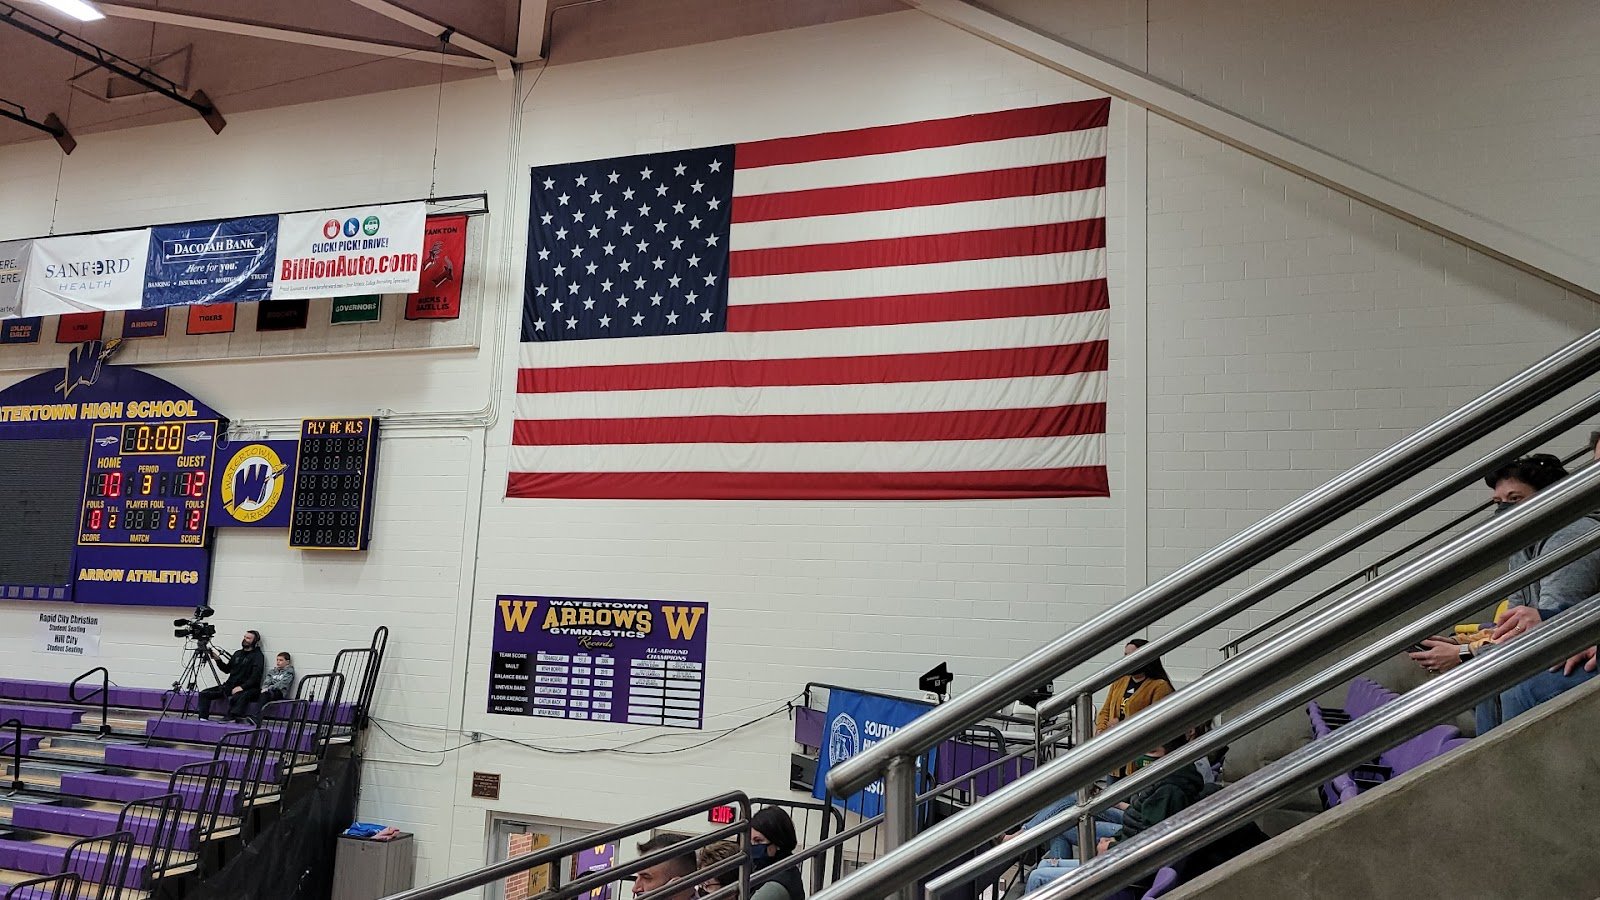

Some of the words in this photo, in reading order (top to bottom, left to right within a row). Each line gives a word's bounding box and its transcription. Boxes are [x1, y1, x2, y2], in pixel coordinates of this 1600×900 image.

[174, 240, 224, 254] DACOTAH
[225, 238, 255, 250] BANK
[312, 240, 337, 254] CLICK!
[338, 239, 361, 252] PICK!
[362, 237, 389, 249] DRIVE!
[45, 257, 131, 279] SANFORD
[186, 264, 205, 273] Here
[205, 263, 218, 273] for
[280, 252, 418, 281] BillionAuto.com
[59, 280, 112, 291] HEALTH
[147, 280, 171, 288] BANKING
[335, 303, 377, 312] GOVERNORS
[130, 320, 157, 328] ARROWS
[80, 402, 123, 419] HIGH
[126, 400, 198, 419] SCHOOL
[308, 422, 326, 435] PLY
[329, 421, 342, 434] AC
[345, 421, 364, 433] KLS
[137, 425, 181, 450] 0:00
[97, 457, 122, 468] HOME
[177, 456, 206, 468] GUEST
[138, 465, 160, 473] PERIOD
[142, 475, 152, 495] 3
[86, 500, 104, 509] FOULS
[126, 500, 148, 508] PLAYER
[150, 500, 165, 508] FOUL
[185, 500, 205, 509] FOULS
[82, 534, 101, 542] SCORE
[130, 534, 150, 542] MATCH
[180, 534, 200, 543] SCORE
[78, 569, 124, 582] ARROW
[126, 569, 199, 584] ATHLETICS
[549, 600, 648, 609] WATERTOWN
[39, 613, 57, 623] Rapid
[57, 614, 69, 624] City
[70, 615, 98, 625] Christian
[499, 600, 538, 632] W
[542, 608, 652, 634] ARROWS
[49, 624, 67, 632] Student
[67, 625, 86, 633] Seating
[661, 606, 705, 640] W
[550, 627, 646, 639] GYMNASTICS
[54, 635, 65, 643] Hill
[65, 635, 78, 645] City
[578, 636, 614, 649] Records
[47, 644, 65, 652] Student
[65, 645, 83, 654] Seating
[864, 720, 894, 738] SOUTH
[712, 806, 730, 823] EXIT
